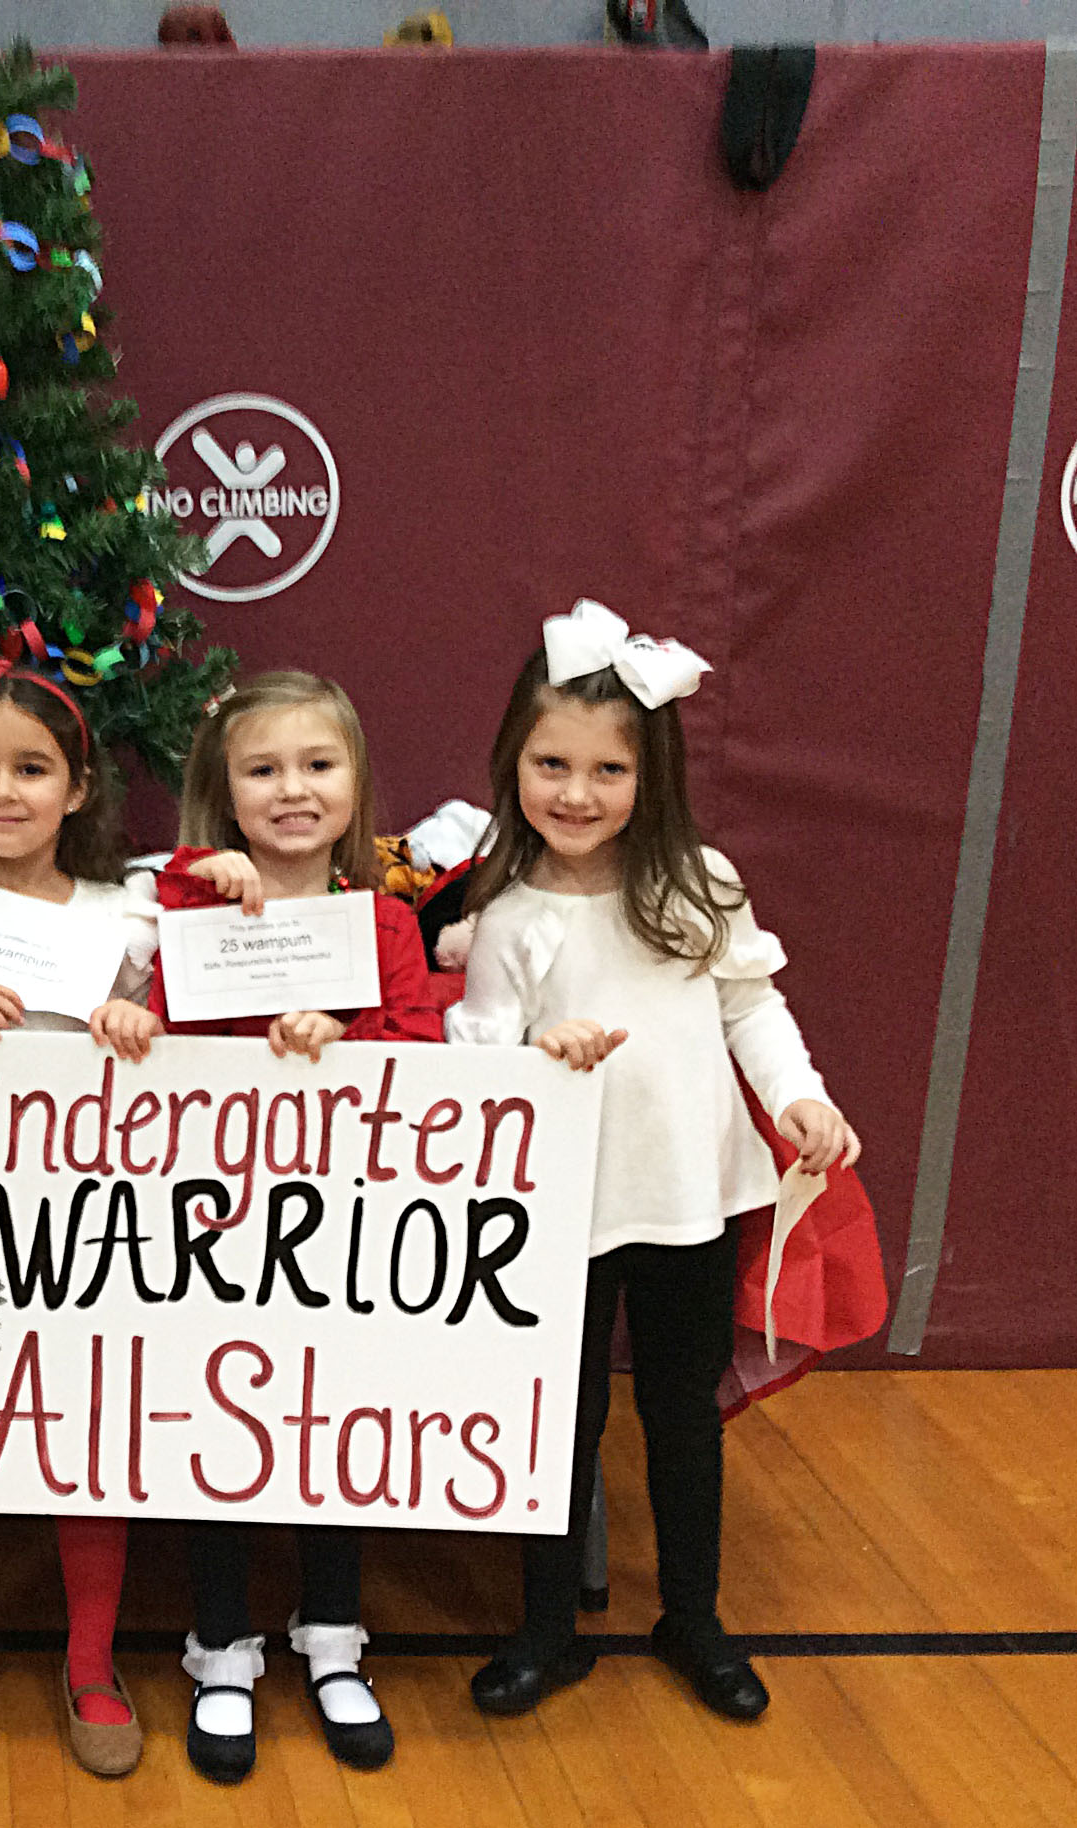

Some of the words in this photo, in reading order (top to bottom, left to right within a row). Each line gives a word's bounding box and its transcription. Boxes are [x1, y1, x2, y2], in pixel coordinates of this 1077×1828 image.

[152, 486, 194, 518] NO
[200, 485, 329, 518] CLIMBING
[220, 938, 239, 953] 25
[243, 934, 313, 951] wampum
